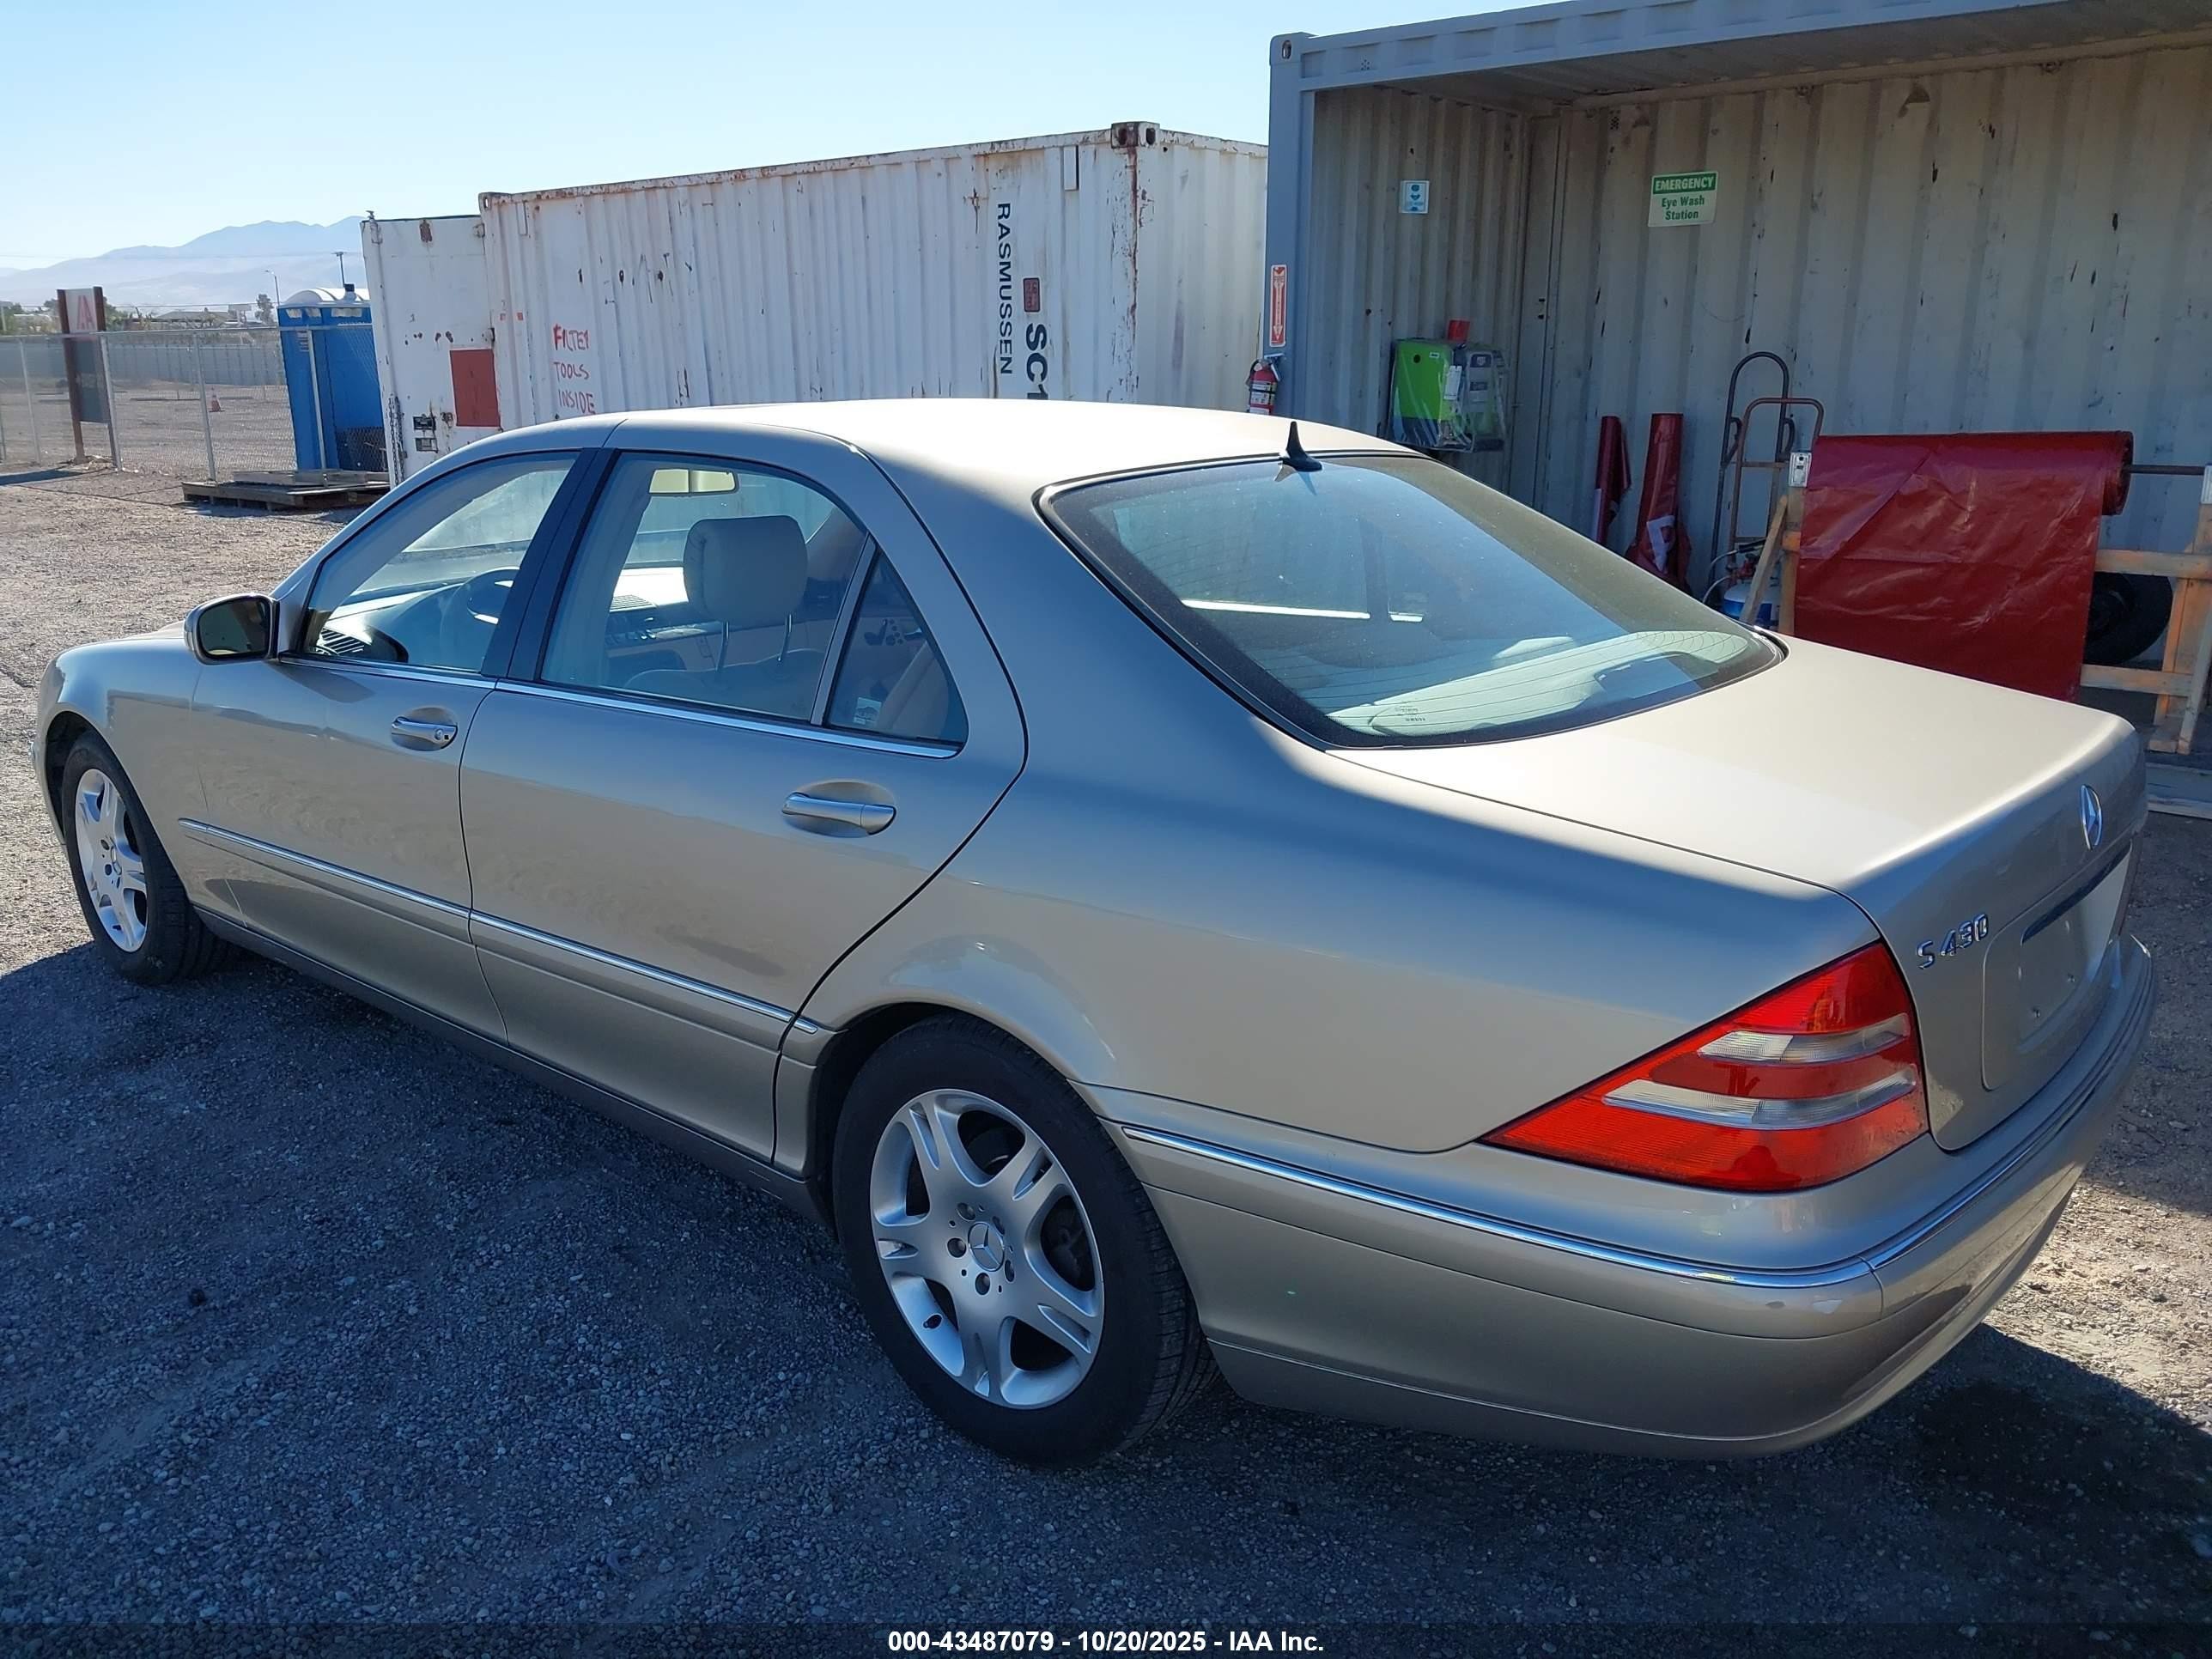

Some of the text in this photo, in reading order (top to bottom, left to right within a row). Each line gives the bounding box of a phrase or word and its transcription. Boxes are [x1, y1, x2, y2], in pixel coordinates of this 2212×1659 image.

[1655, 177, 1714, 191] EMERGENCY
[1662, 195, 1705, 210] Eye Wash
[1665, 210, 1698, 220] Station
[998, 203, 1013, 374] RASMUSSEN
[553, 362, 589, 383] TOOLS
[558, 389, 595, 415] INSIDE
[1917, 913, 1989, 969] S 430
